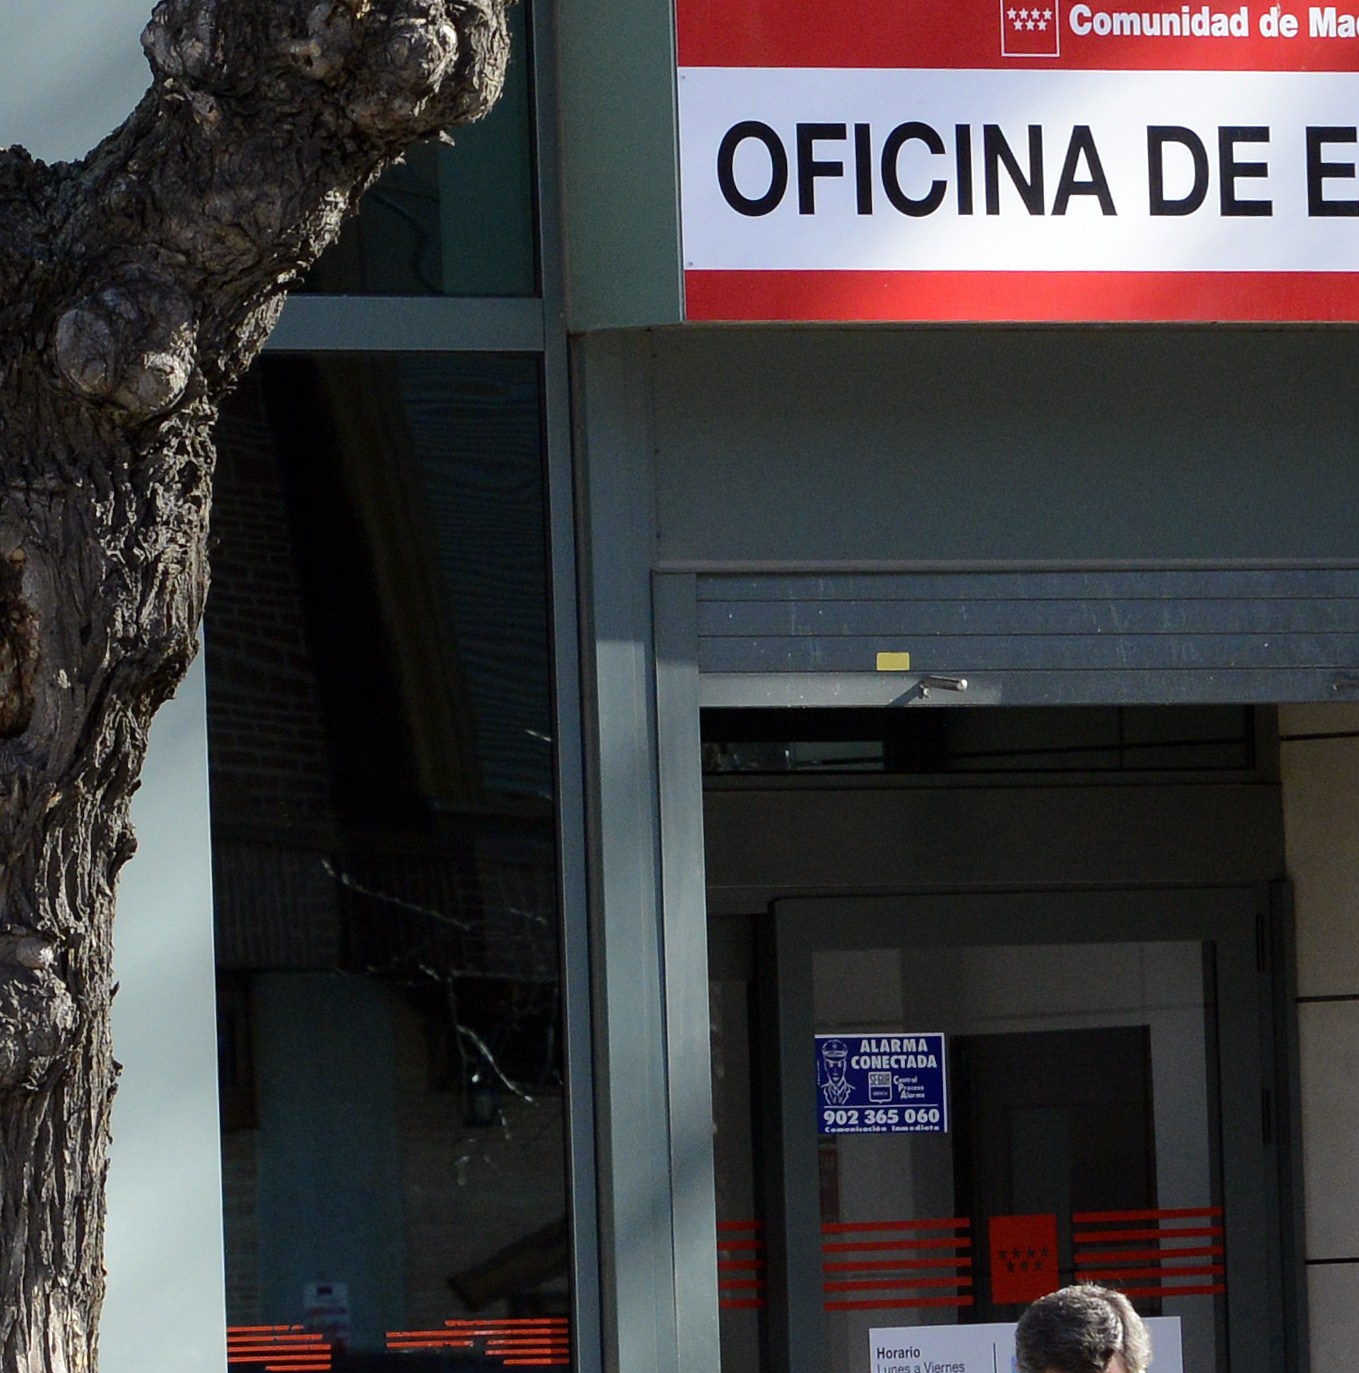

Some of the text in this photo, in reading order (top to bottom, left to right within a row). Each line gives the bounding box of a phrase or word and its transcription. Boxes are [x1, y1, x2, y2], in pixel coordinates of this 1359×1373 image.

[1069, 4, 1249, 37] Comunidad
[1259, 6, 1298, 37] de
[716, 120, 1118, 217] OFICINA
[1149, 125, 1274, 217] DE
[860, 1038, 928, 1053] ALARMA
[851, 1054, 937, 1069] CONECTADA
[823, 1108, 940, 1125] 902 365 060
[877, 1346, 920, 1359] Horario
[924, 1362, 965, 1373] Viernes
